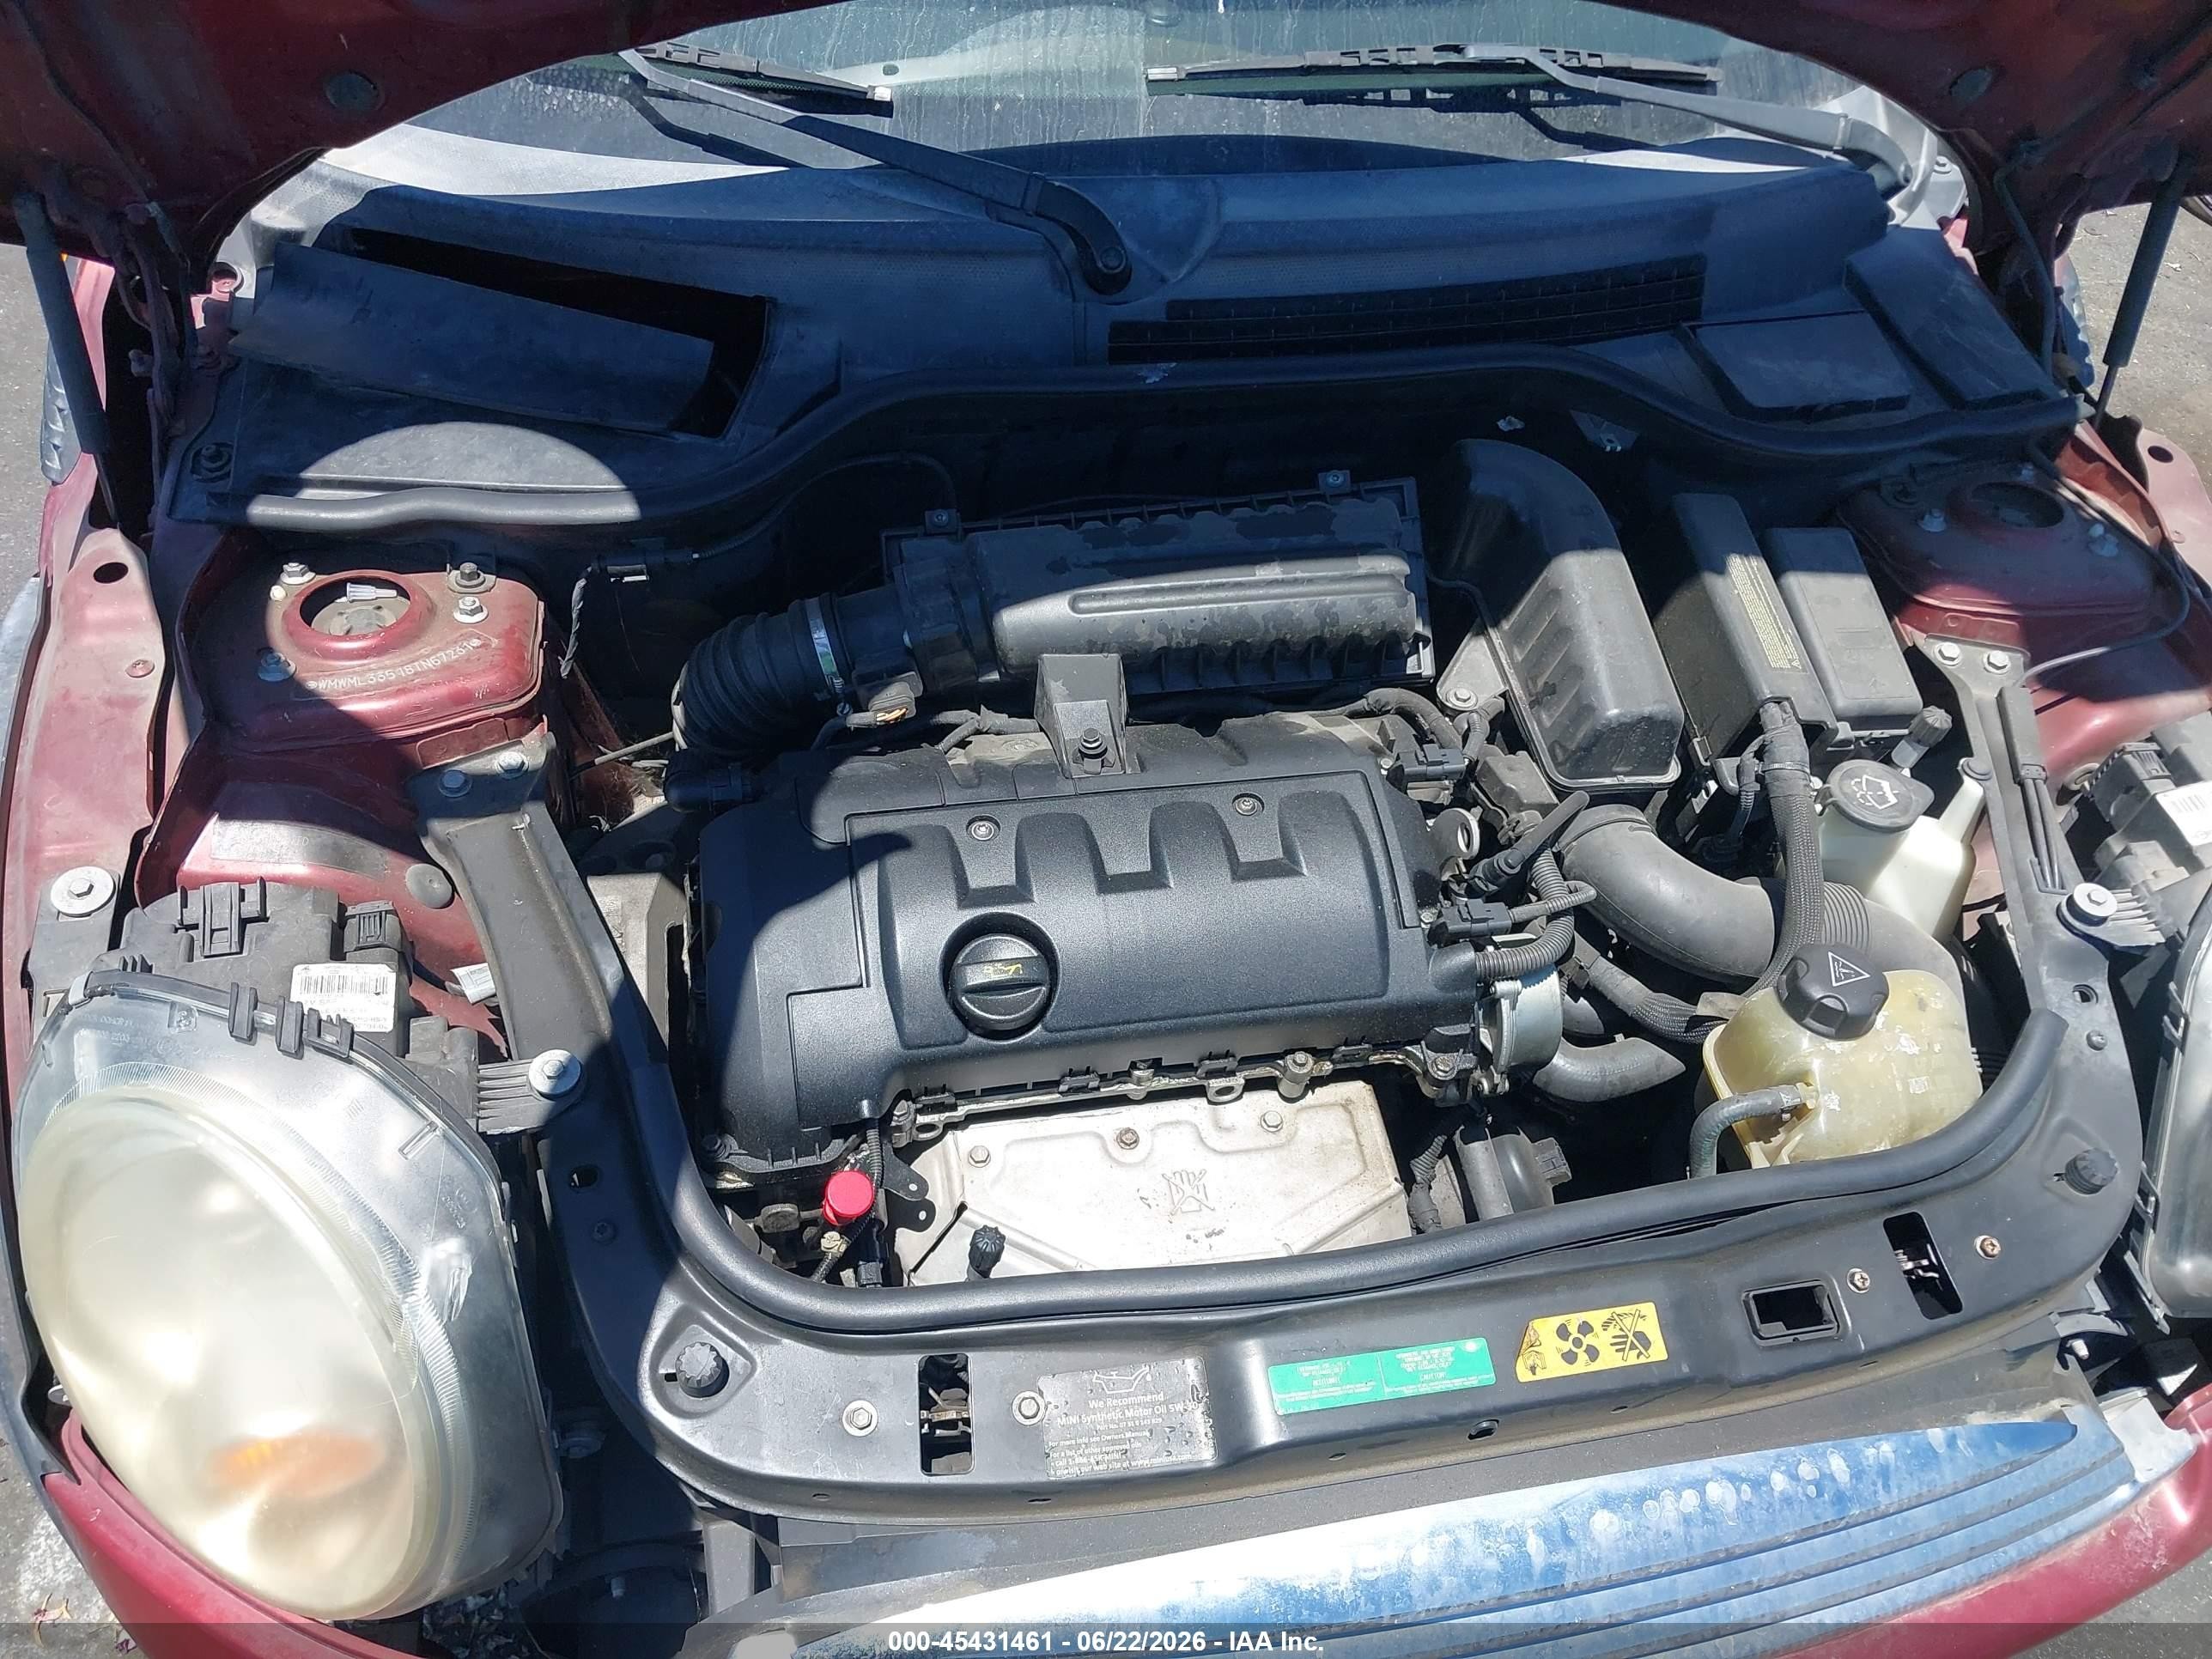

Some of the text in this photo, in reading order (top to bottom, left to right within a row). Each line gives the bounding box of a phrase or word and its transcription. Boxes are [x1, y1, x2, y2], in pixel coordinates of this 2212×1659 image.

[1088, 1391, 1164, 1408] We Recommend
[1057, 1414, 1080, 1426] MINI
[1081, 1409, 1124, 1425] Synthetic
[1125, 1407, 1152, 1419] Motor
[1154, 1404, 1167, 1415] Oil
